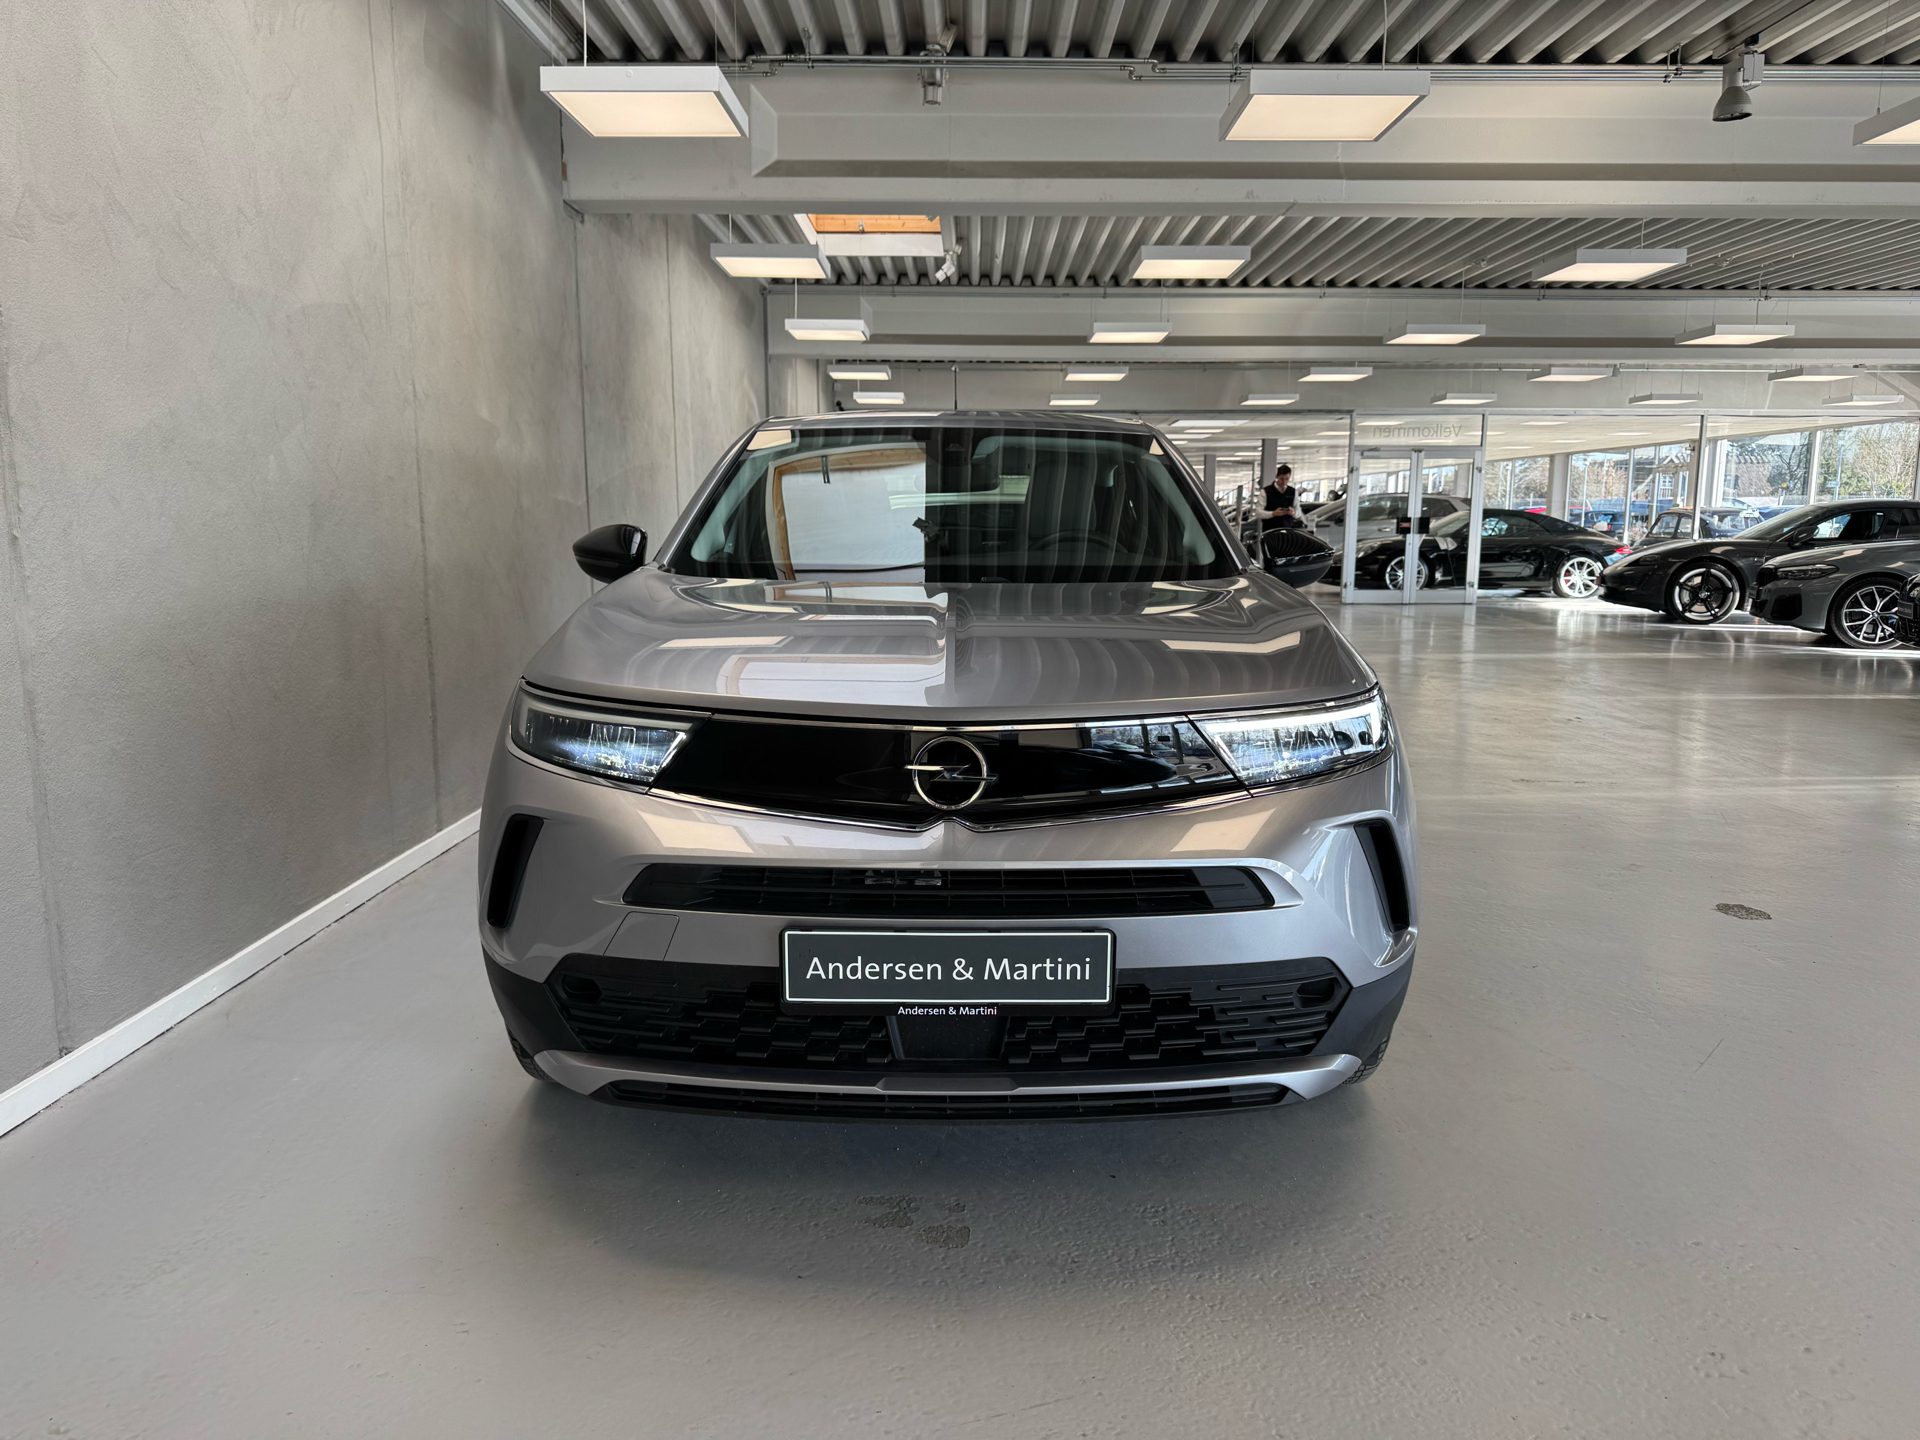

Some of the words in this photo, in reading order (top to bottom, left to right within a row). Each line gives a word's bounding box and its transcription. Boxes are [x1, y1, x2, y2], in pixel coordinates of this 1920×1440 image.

[805, 955, 942, 981] Andersen
[952, 957, 974, 981] &
[983, 957, 1091, 981] Martini
[897, 1005, 946, 1016] Andersen
[948, 1006, 957, 1016] &
[959, 1005, 998, 1016] Martini
